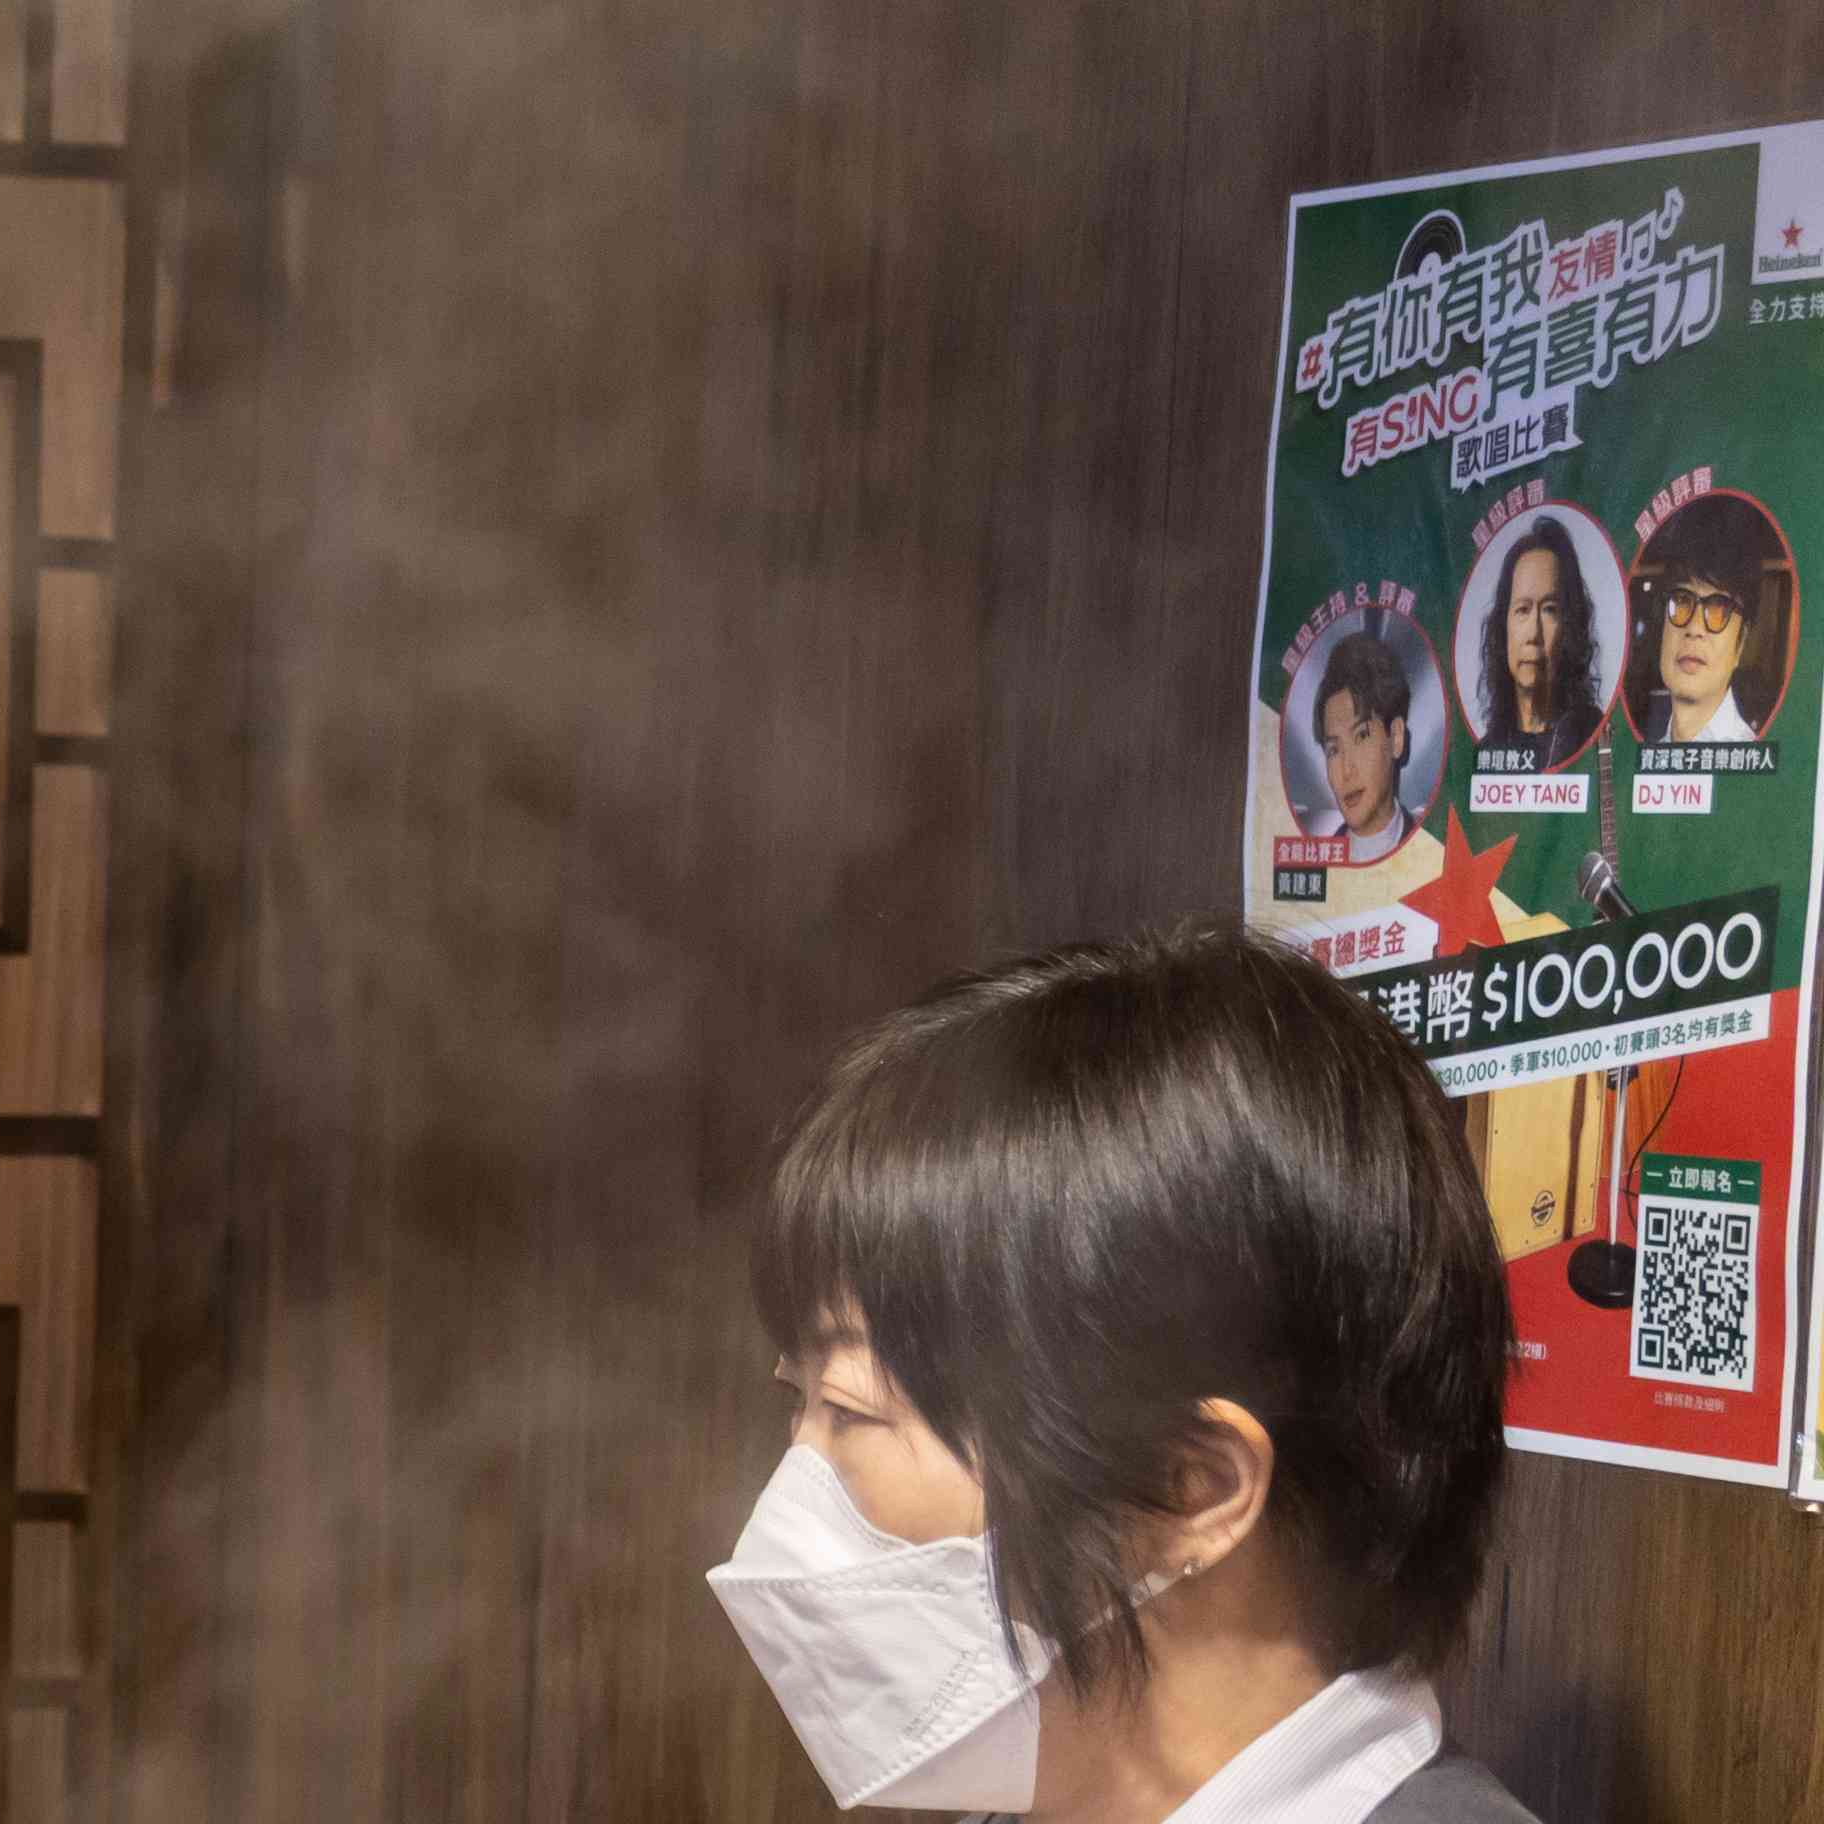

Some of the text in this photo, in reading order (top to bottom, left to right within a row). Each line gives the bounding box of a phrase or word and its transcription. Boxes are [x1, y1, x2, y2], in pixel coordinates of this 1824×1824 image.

[1457, 404, 1569, 478] 歌唱比賽
[1475, 784, 1581, 804] JOEY TANG
[1638, 784, 1702, 805] DJ YIN
[1480, 911, 1763, 1032] $100,000
[1667, 1166, 1733, 1194] 立即報名
